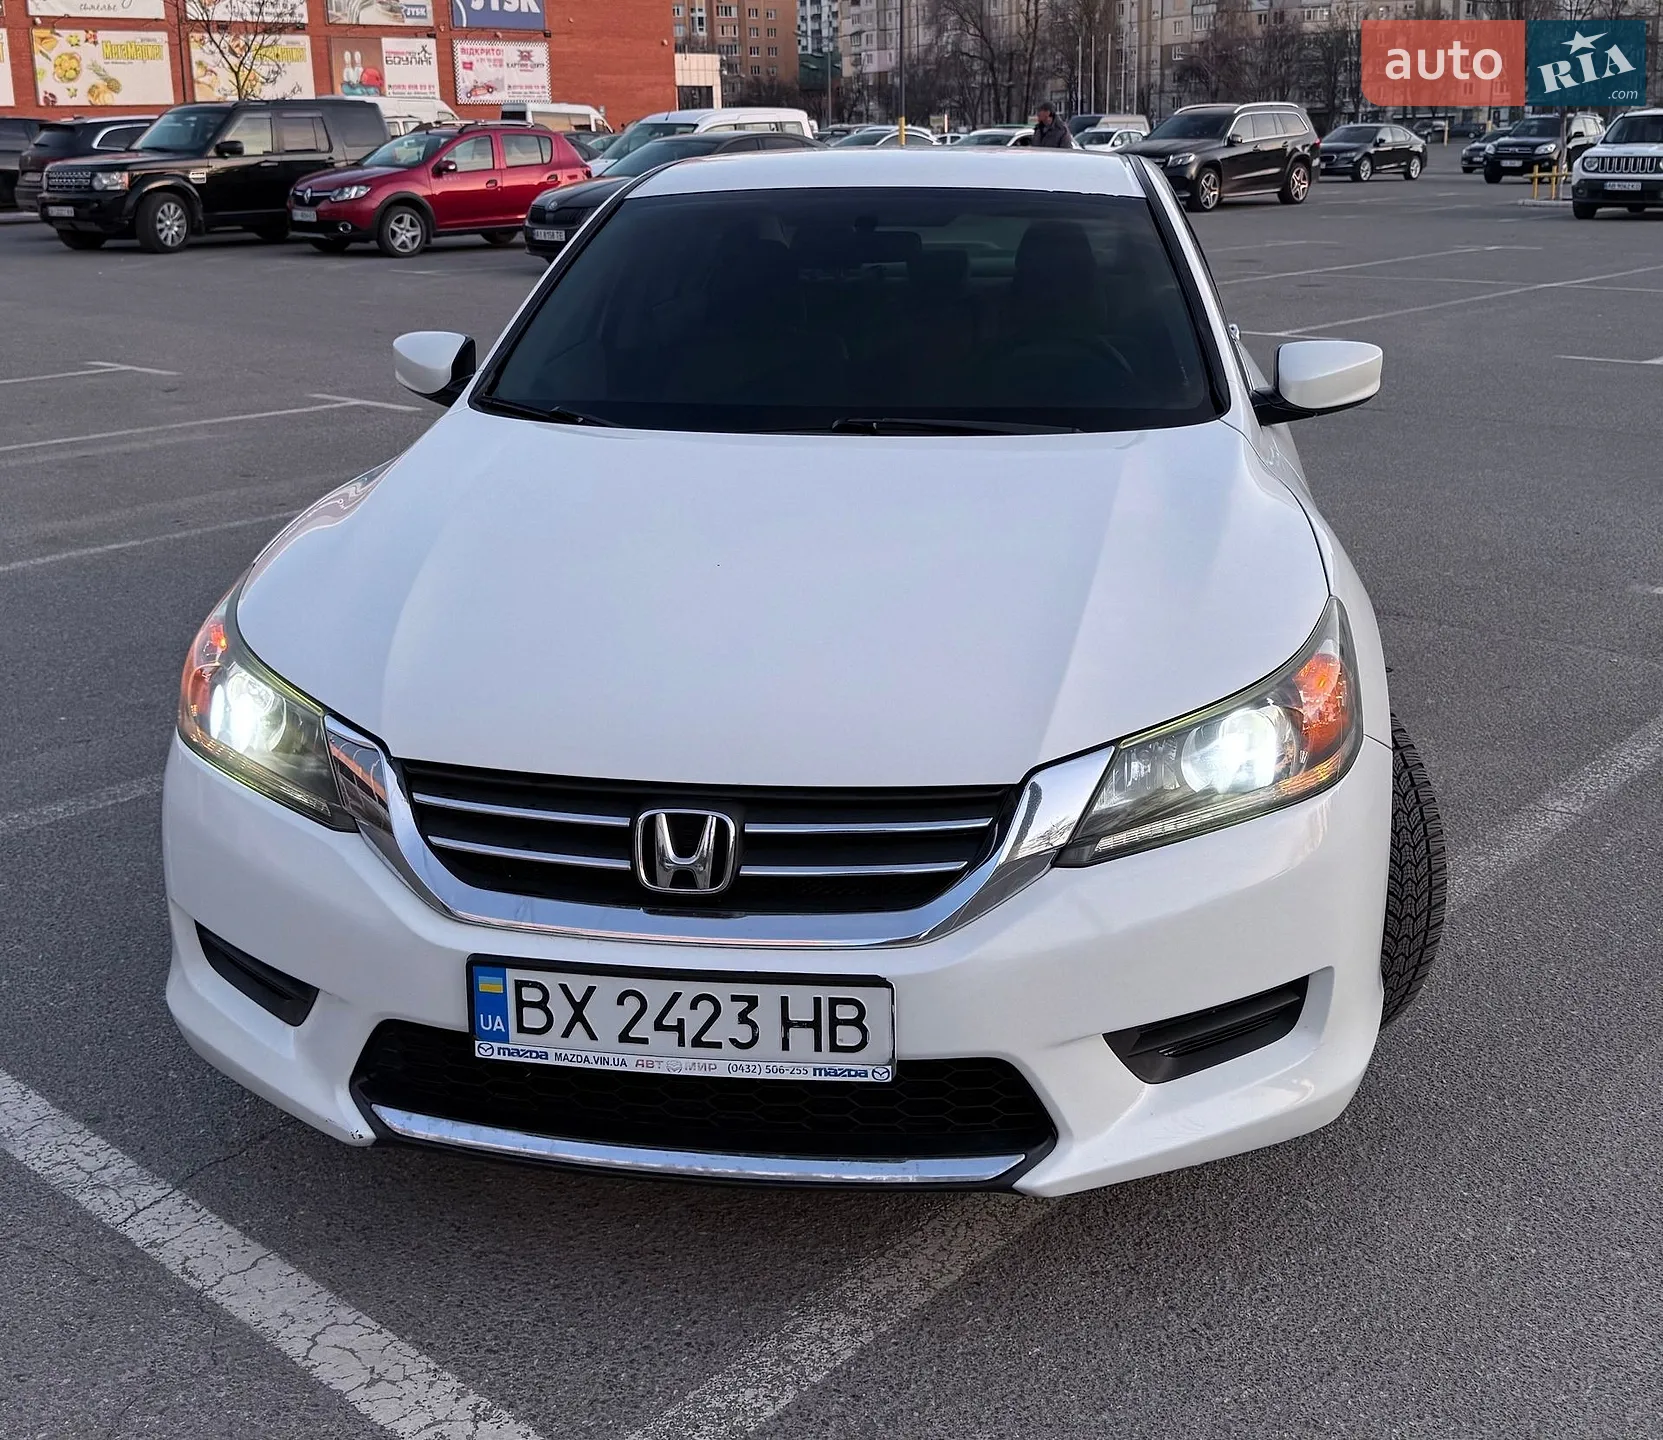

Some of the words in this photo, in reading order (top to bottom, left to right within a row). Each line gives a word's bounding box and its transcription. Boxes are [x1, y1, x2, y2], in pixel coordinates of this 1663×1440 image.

[406, 7, 427, 16] JYSK
[479, 1014, 506, 1033] UA
[514, 978, 599, 1041] BX
[616, 988, 761, 1050] 2423
[780, 995, 870, 1053] HB
[497, 1046, 549, 1061] mazda
[554, 1051, 628, 1068] MAZDA.VIN.UA
[727, 1062, 762, 1075] (0432)
[765, 1063, 809, 1075] 506-255
[812, 1067, 868, 1078] mazda
